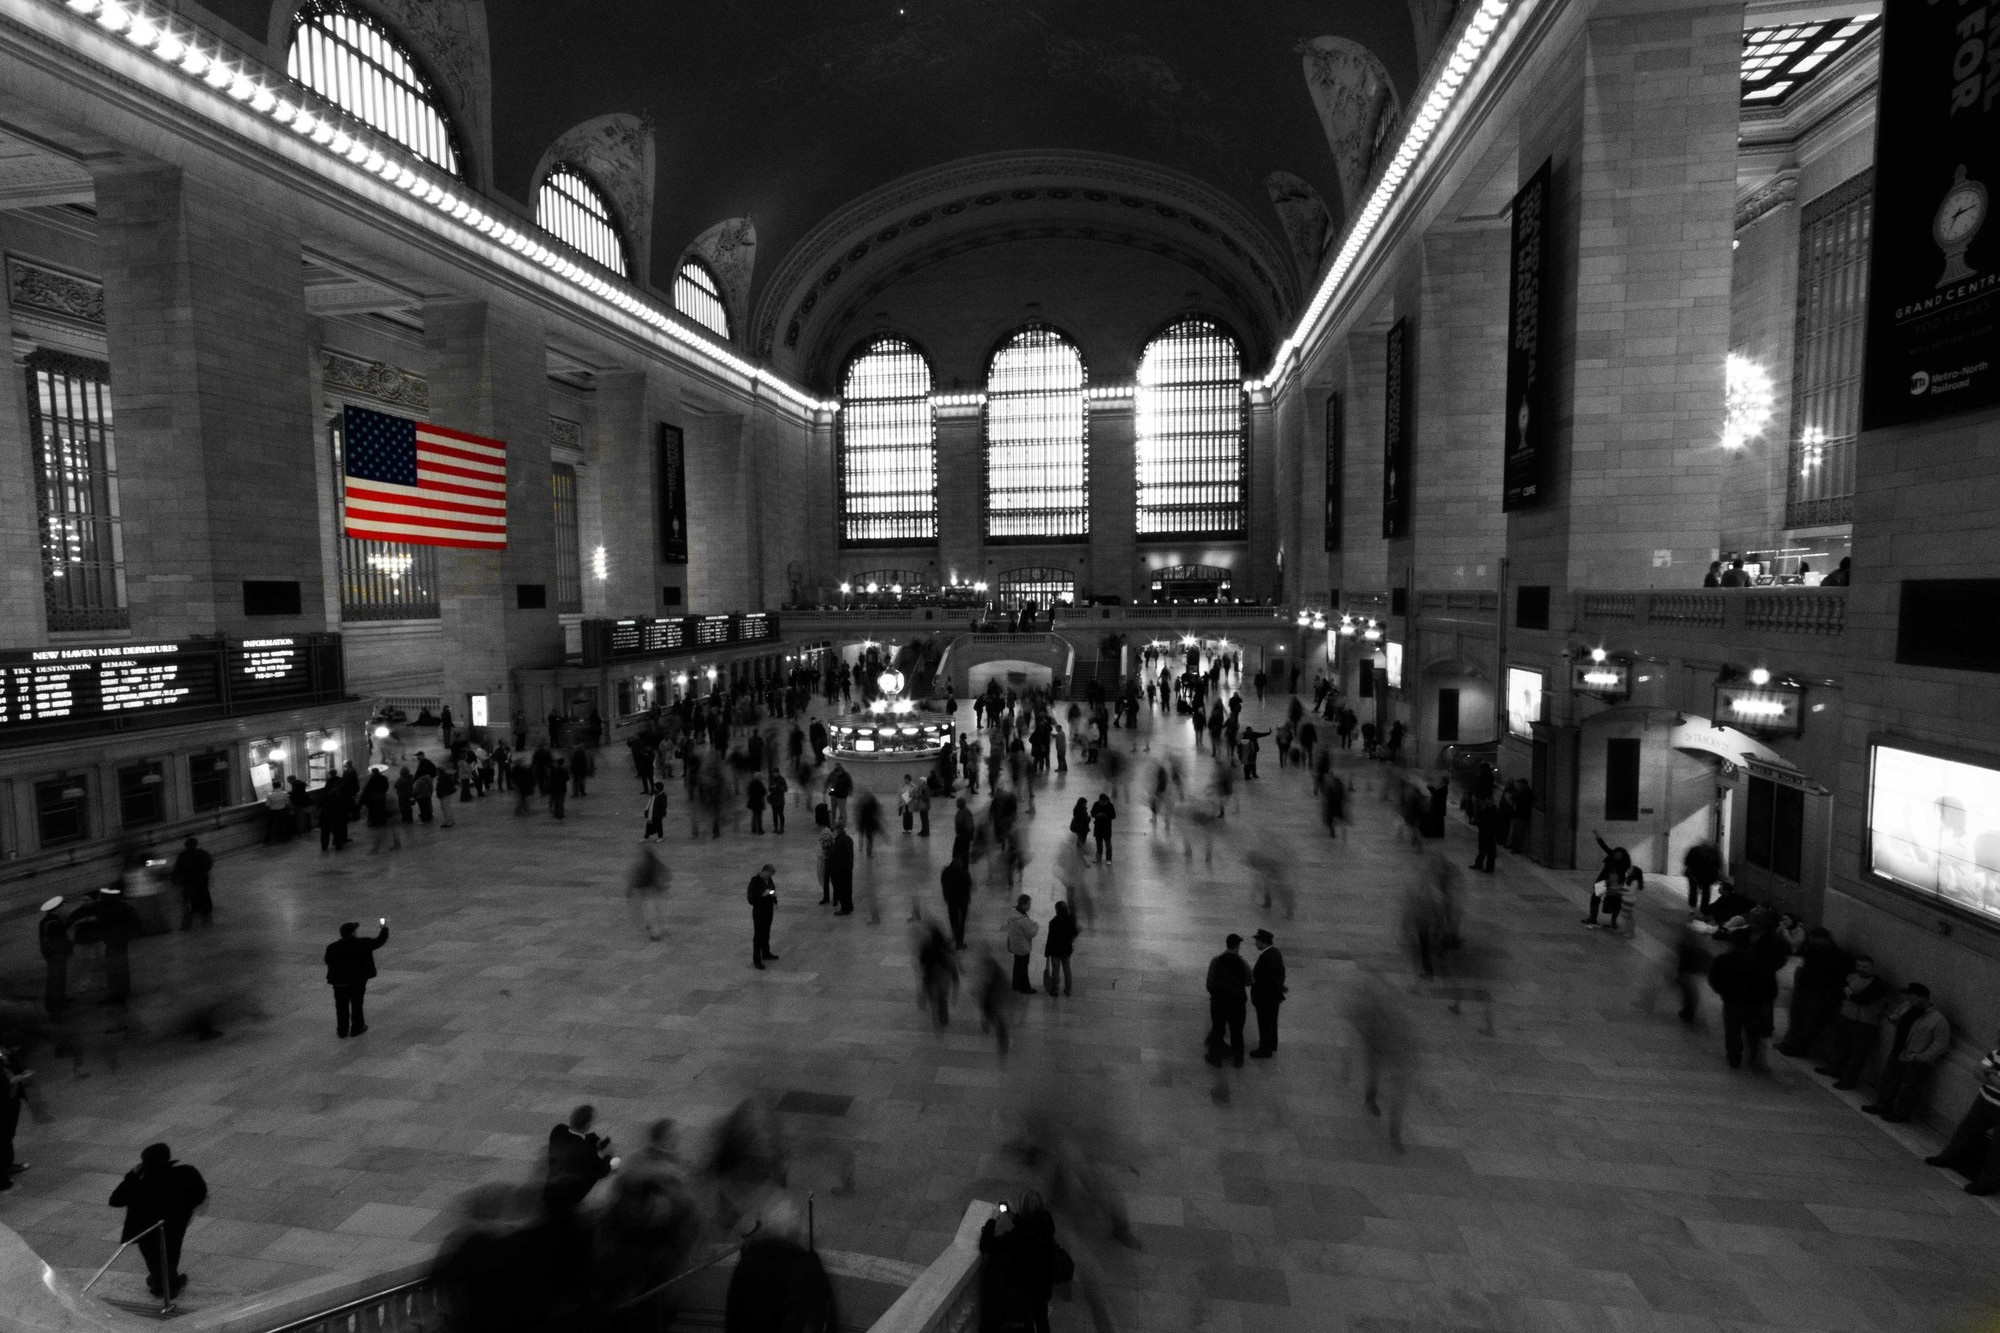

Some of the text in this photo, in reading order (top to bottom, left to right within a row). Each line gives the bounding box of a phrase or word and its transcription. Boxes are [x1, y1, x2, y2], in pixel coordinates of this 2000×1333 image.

[1951, 6, 1986, 119] FOR
[1895, 295, 1942, 319] GRAND
[1931, 360, 1990, 384] Metro-North
[1931, 377, 1971, 395] Railroad
[243, 638, 294, 647] INFORMATION
[33, 644, 179, 660] NEW HAVEN LINE DEPARTURES
[12, 660, 138, 675] TRK DESTINATION REMARKS
